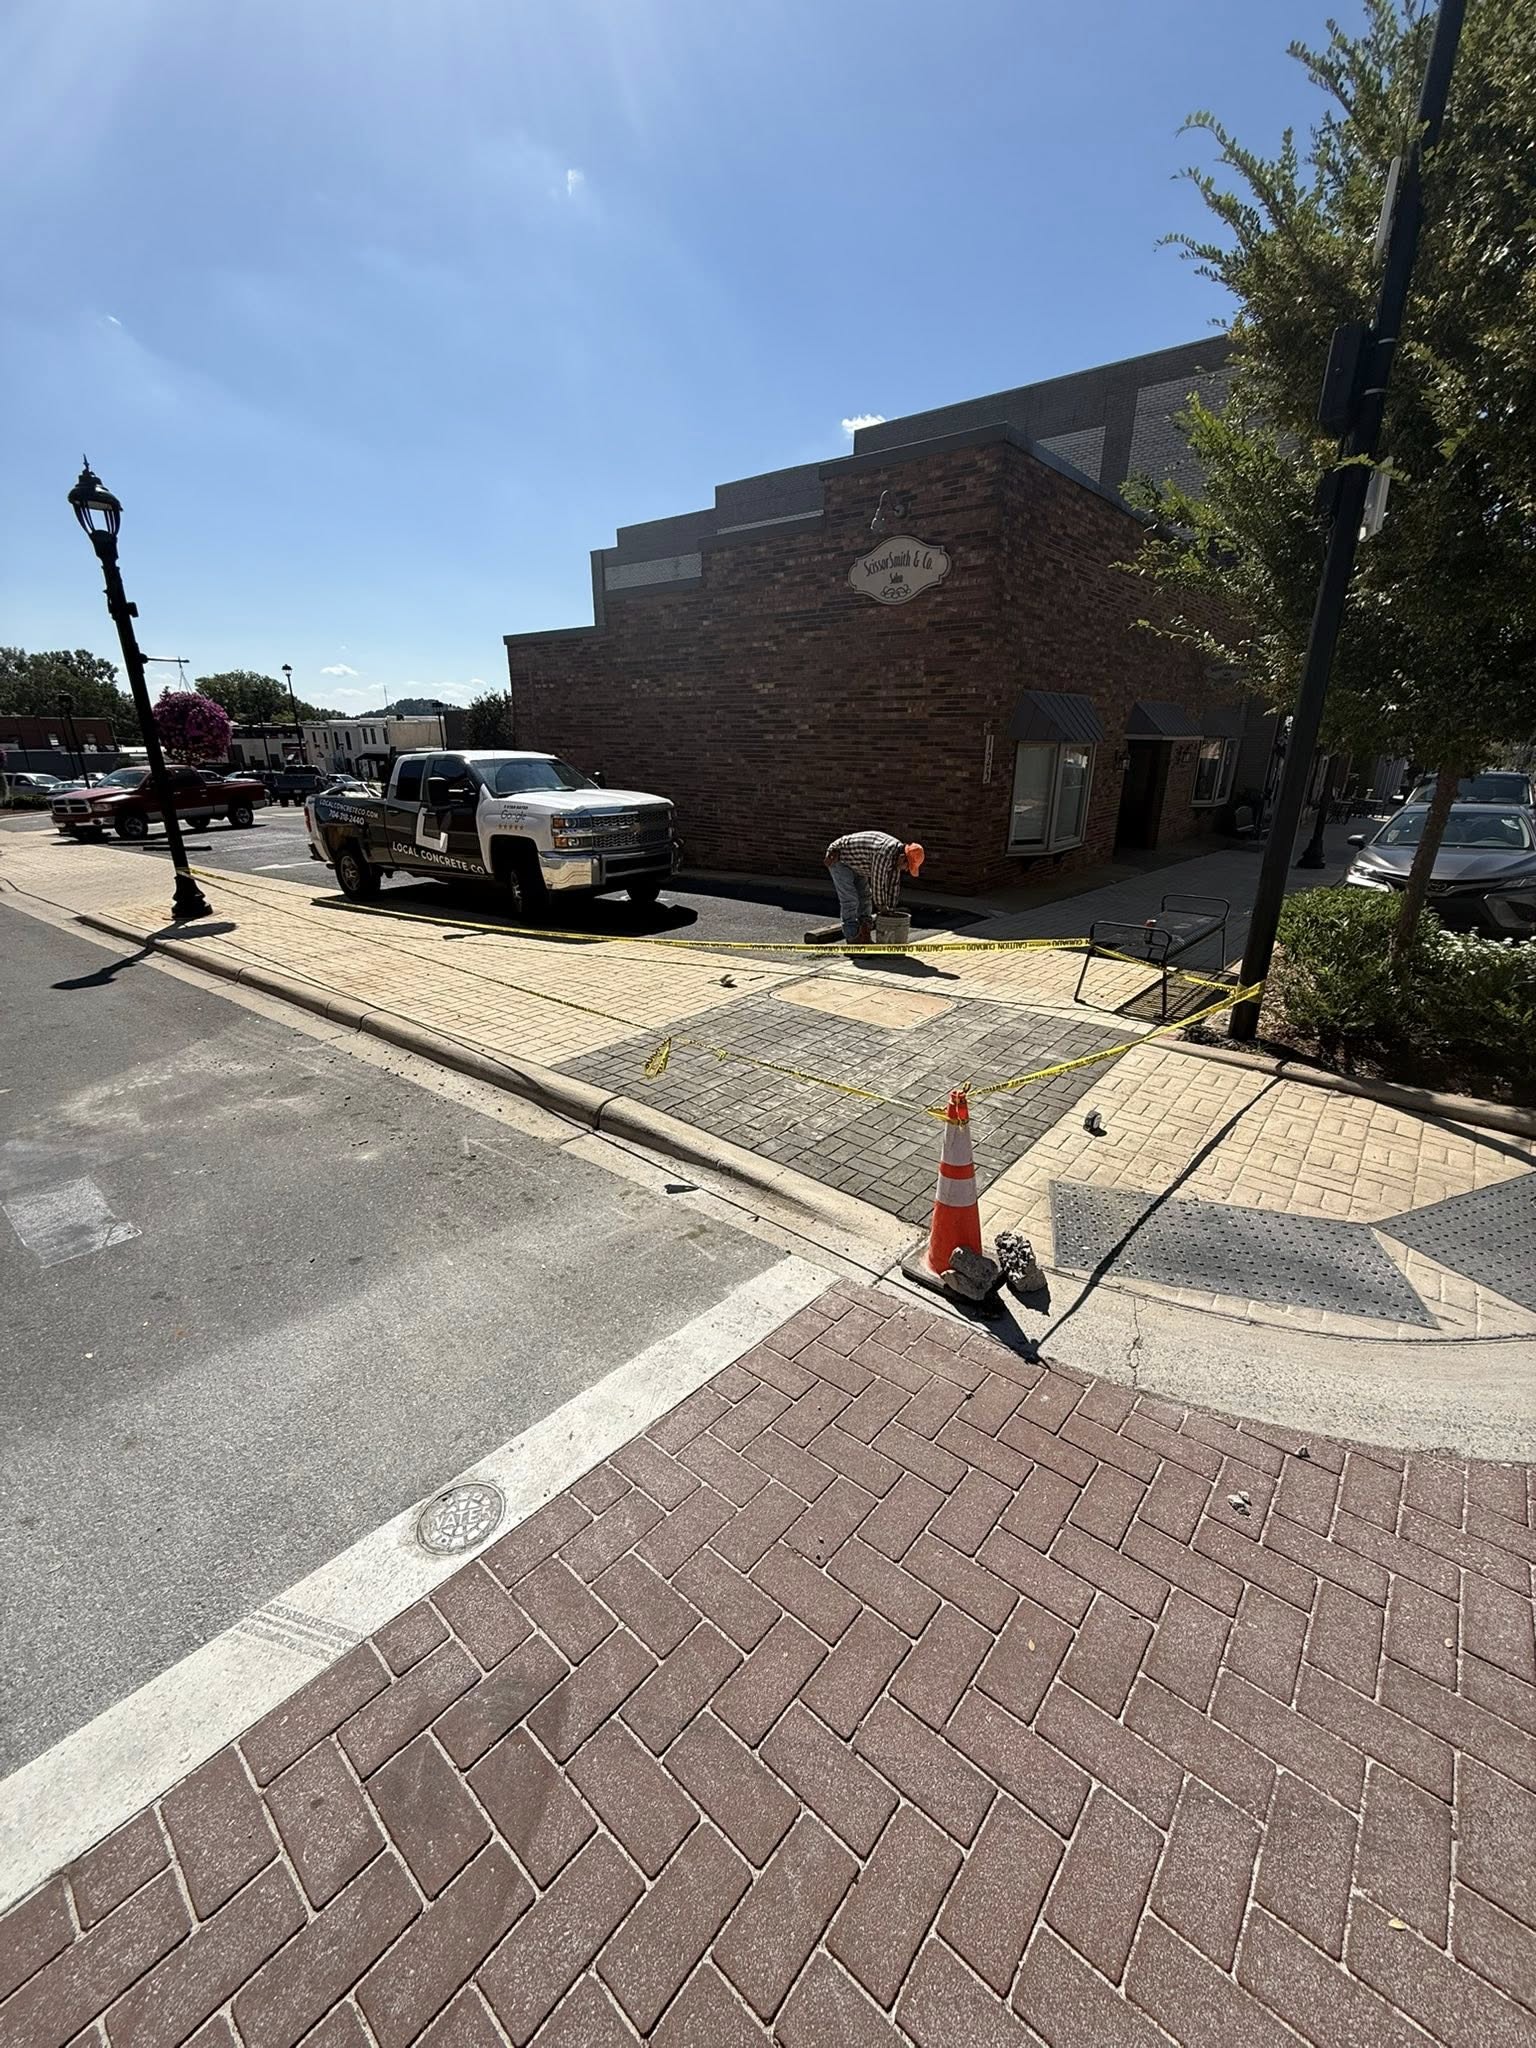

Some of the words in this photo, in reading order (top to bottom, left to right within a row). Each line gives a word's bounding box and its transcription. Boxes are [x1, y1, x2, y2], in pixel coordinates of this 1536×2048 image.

[863, 549, 911, 577] ScissorSmith
[913, 550, 920, 568] &
[392, 841, 419, 858] LOCAL
[420, 850, 469, 871] CONCRETE
[915, 944, 944, 952] CAUTION
[966, 943, 996, 951] CUIDADO
[997, 942, 1028, 950] CAUTION
